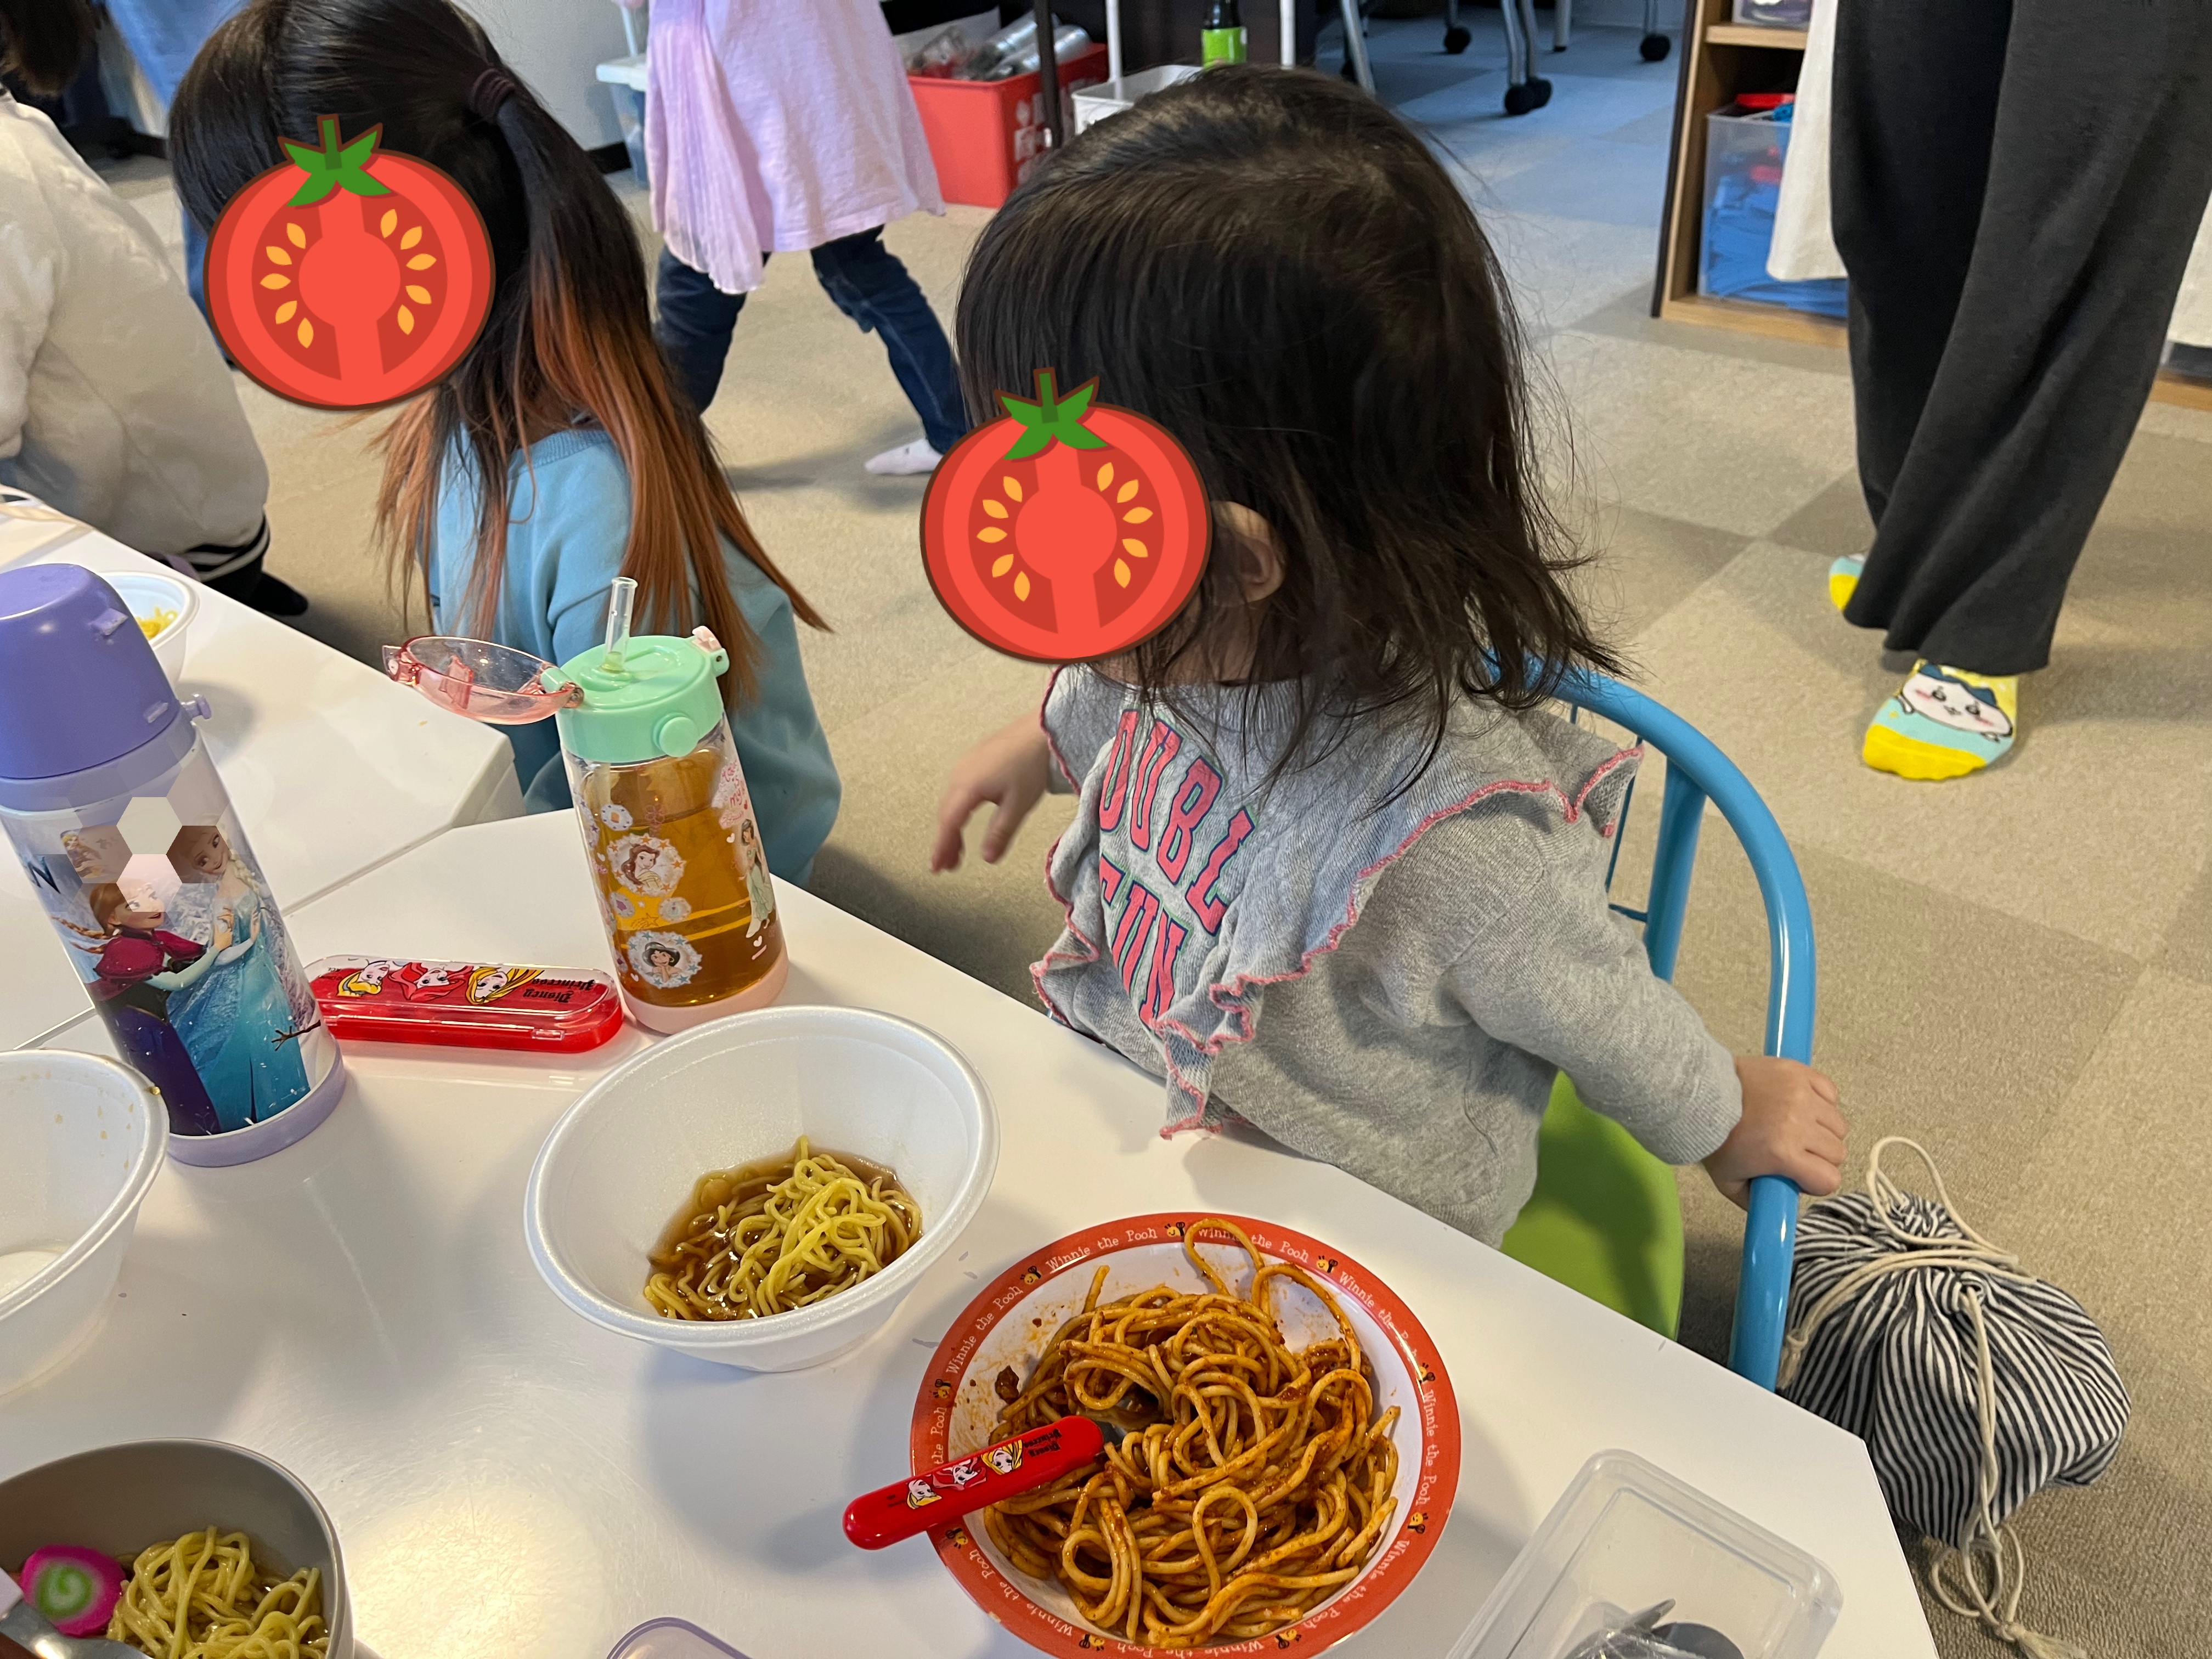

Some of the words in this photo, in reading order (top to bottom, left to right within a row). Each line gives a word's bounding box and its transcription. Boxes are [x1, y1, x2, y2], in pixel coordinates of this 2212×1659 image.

[522, 989, 574, 1003] Disney
[531, 979, 596, 991] Princess
[1045, 1246, 1091, 1272] Winnie
[1097, 1237, 1119, 1249] the
[1126, 1227, 1158, 1242] Pooh
[1251, 1234, 1272, 1249] the
[1279, 1240, 1309, 1263] Pooh
[1339, 1271, 1374, 1308] Winnie
[1378, 1308, 1394, 1330] the
[946, 1335, 977, 1374] Winnie
[975, 1312, 995, 1330] the
[993, 1285, 1024, 1310] Pooh
[930, 1407, 947, 1436] Pooh
[1423, 1389, 1439, 1437] Winnie
[934, 1444, 944, 1464] the
[1425, 1443, 1440, 1467] the
[1415, 1474, 1437, 1506] Pooh
[969, 1549, 996, 1579] Pooh
[1369, 1539, 1410, 1581] Winnie
[1000, 1581, 1020, 1601] the
[1342, 1585, 1367, 1604] the
[1026, 1602, 1073, 1637] Winnie
[1302, 1606, 1341, 1629] Pooh
